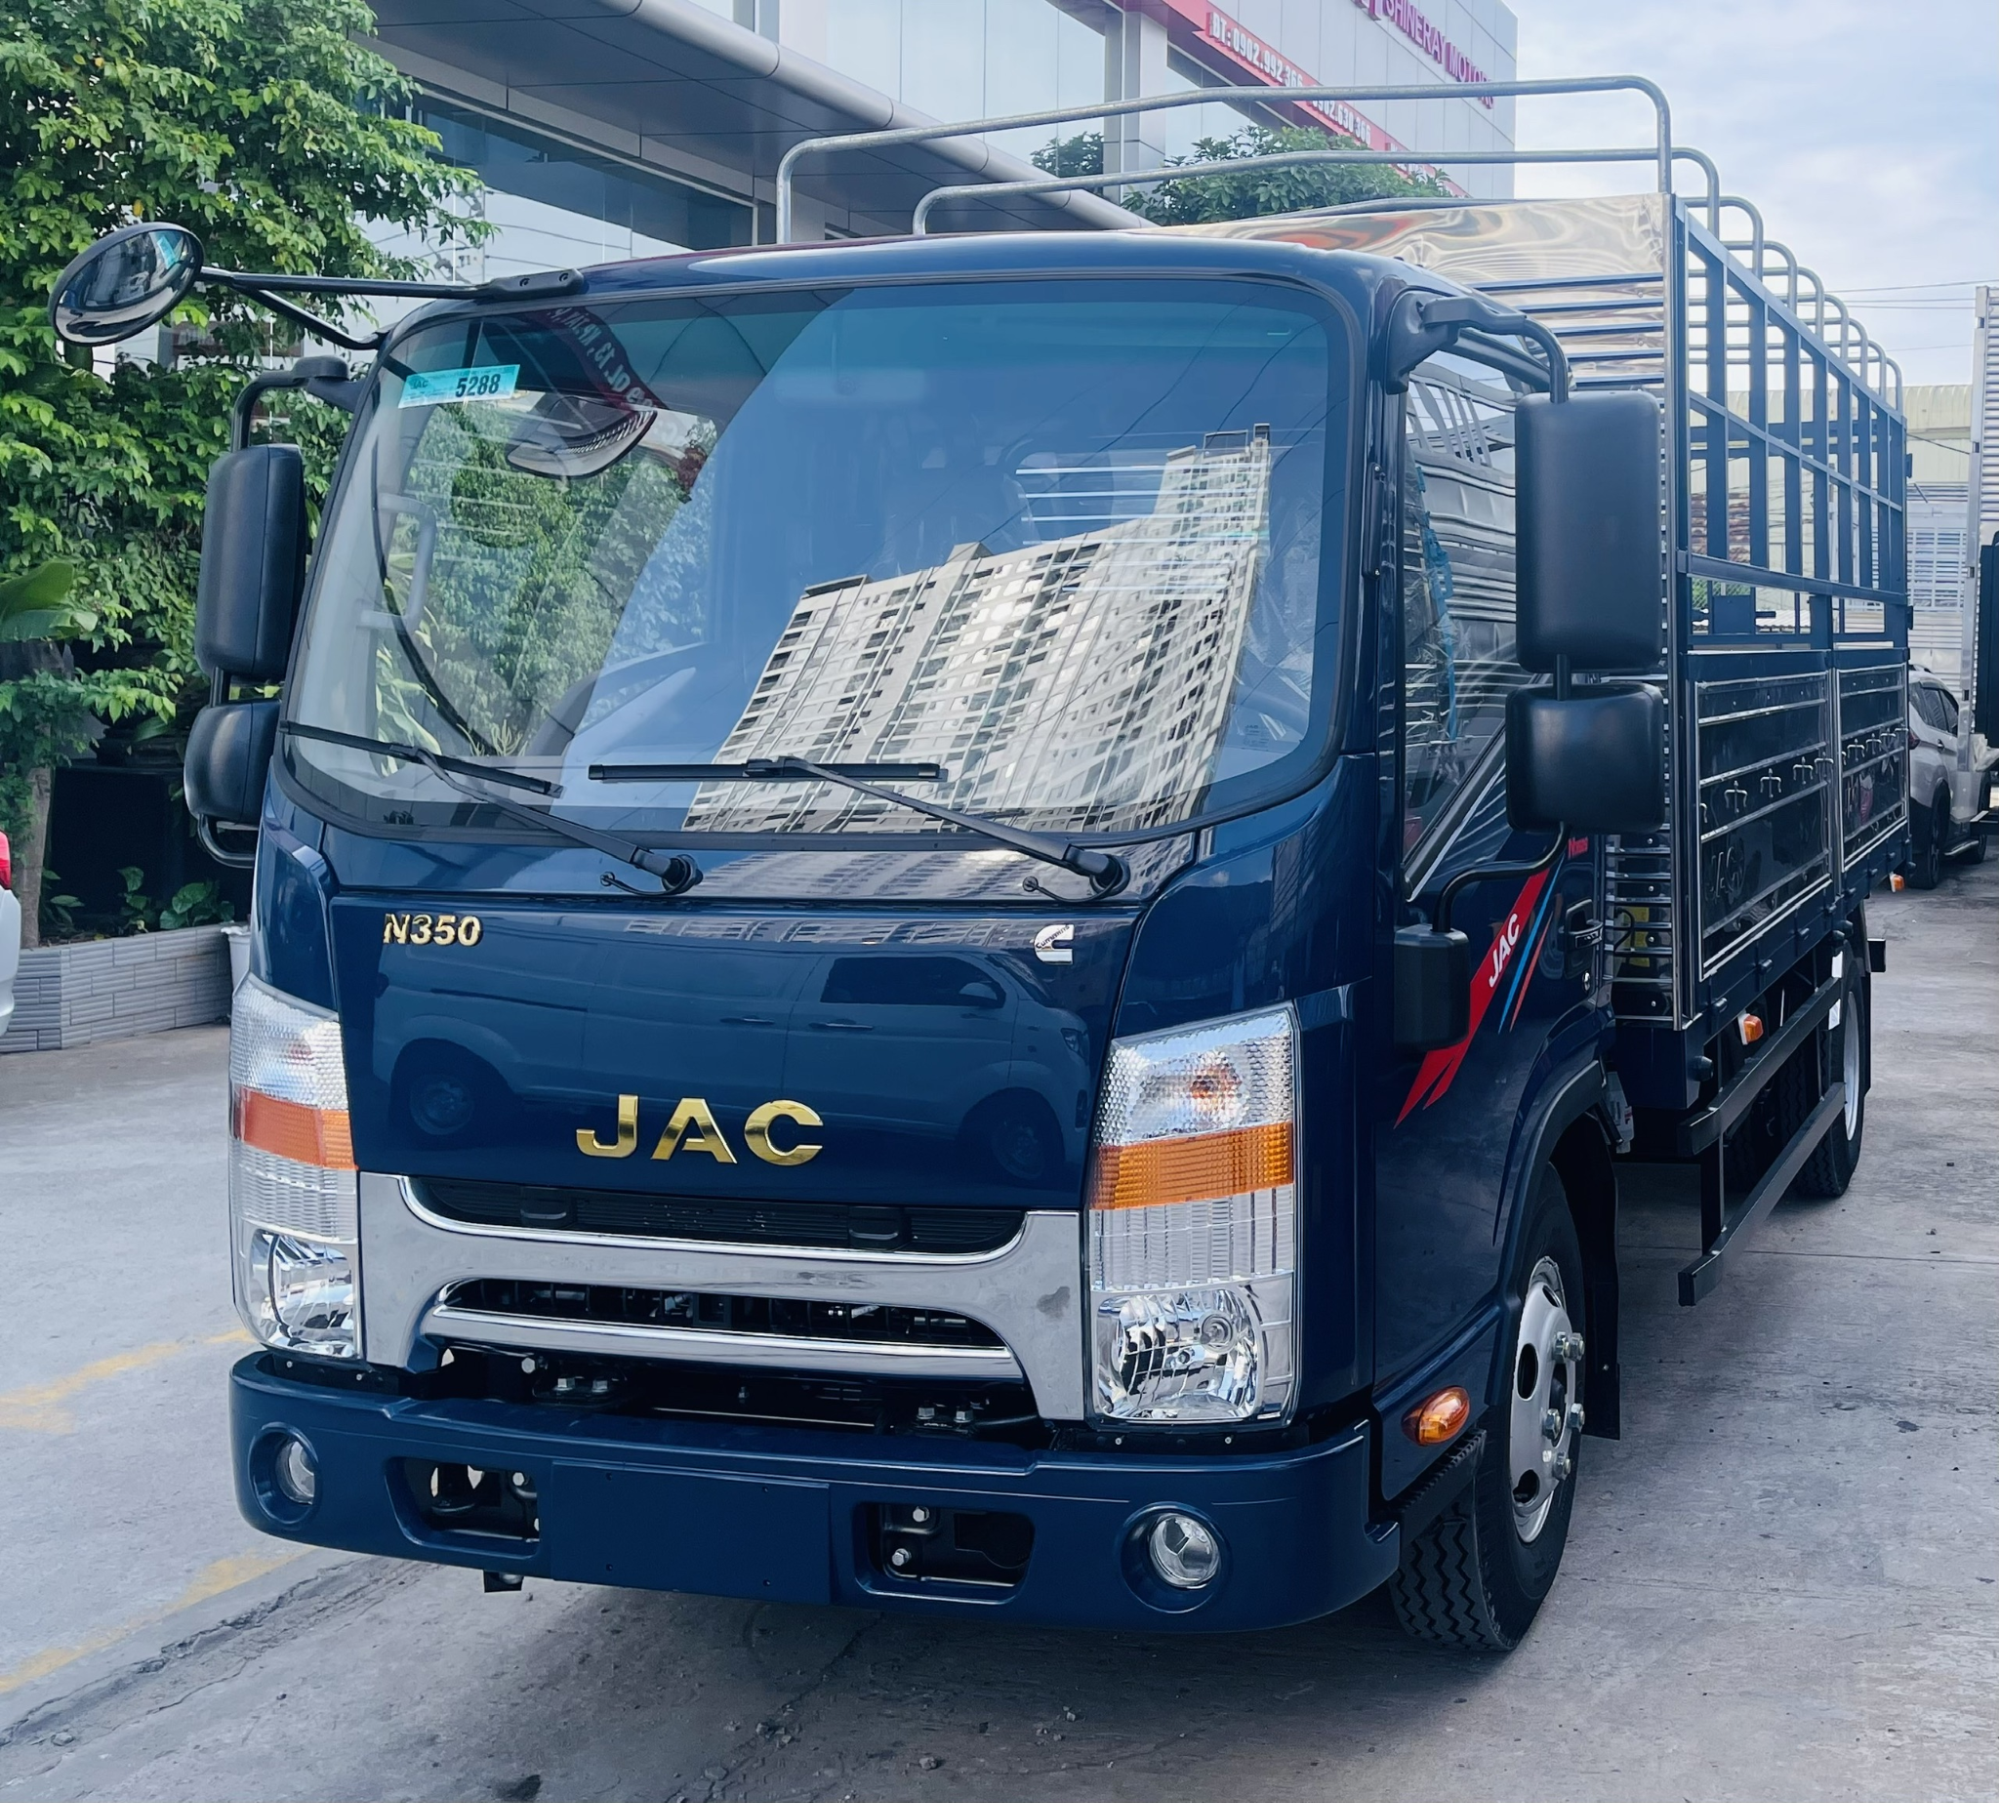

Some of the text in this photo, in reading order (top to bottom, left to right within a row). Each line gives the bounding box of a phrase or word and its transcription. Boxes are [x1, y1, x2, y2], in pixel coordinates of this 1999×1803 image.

[455, 373, 501, 398] 5288
[383, 913, 481, 947] N350
[1488, 913, 1519, 988] JAC
[576, 1093, 824, 1166] JAC
